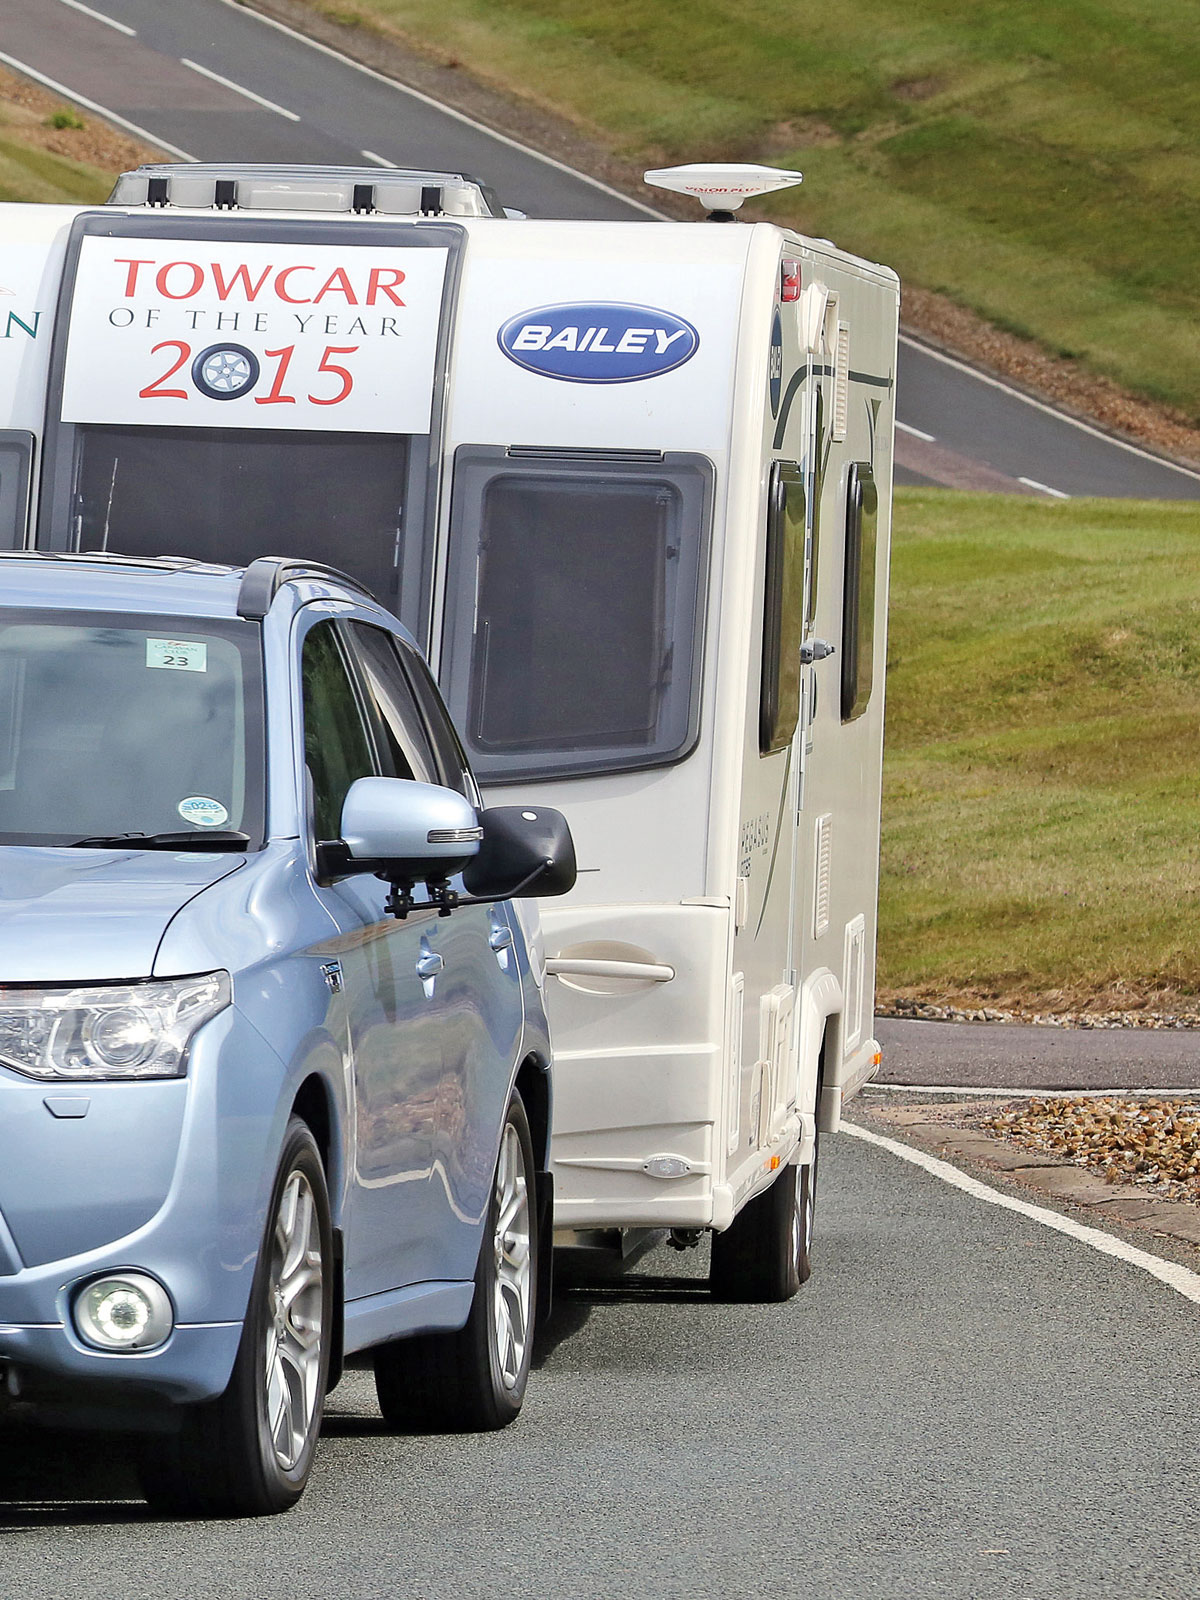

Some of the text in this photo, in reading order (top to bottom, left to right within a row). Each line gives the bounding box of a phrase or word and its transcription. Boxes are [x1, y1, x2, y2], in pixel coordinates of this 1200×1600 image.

[113, 258, 407, 307] TOWCAR
[108, 307, 404, 337] OF THE YEAR
[511, 325, 687, 354] BAILEY
[163, 655, 189, 667] 23
